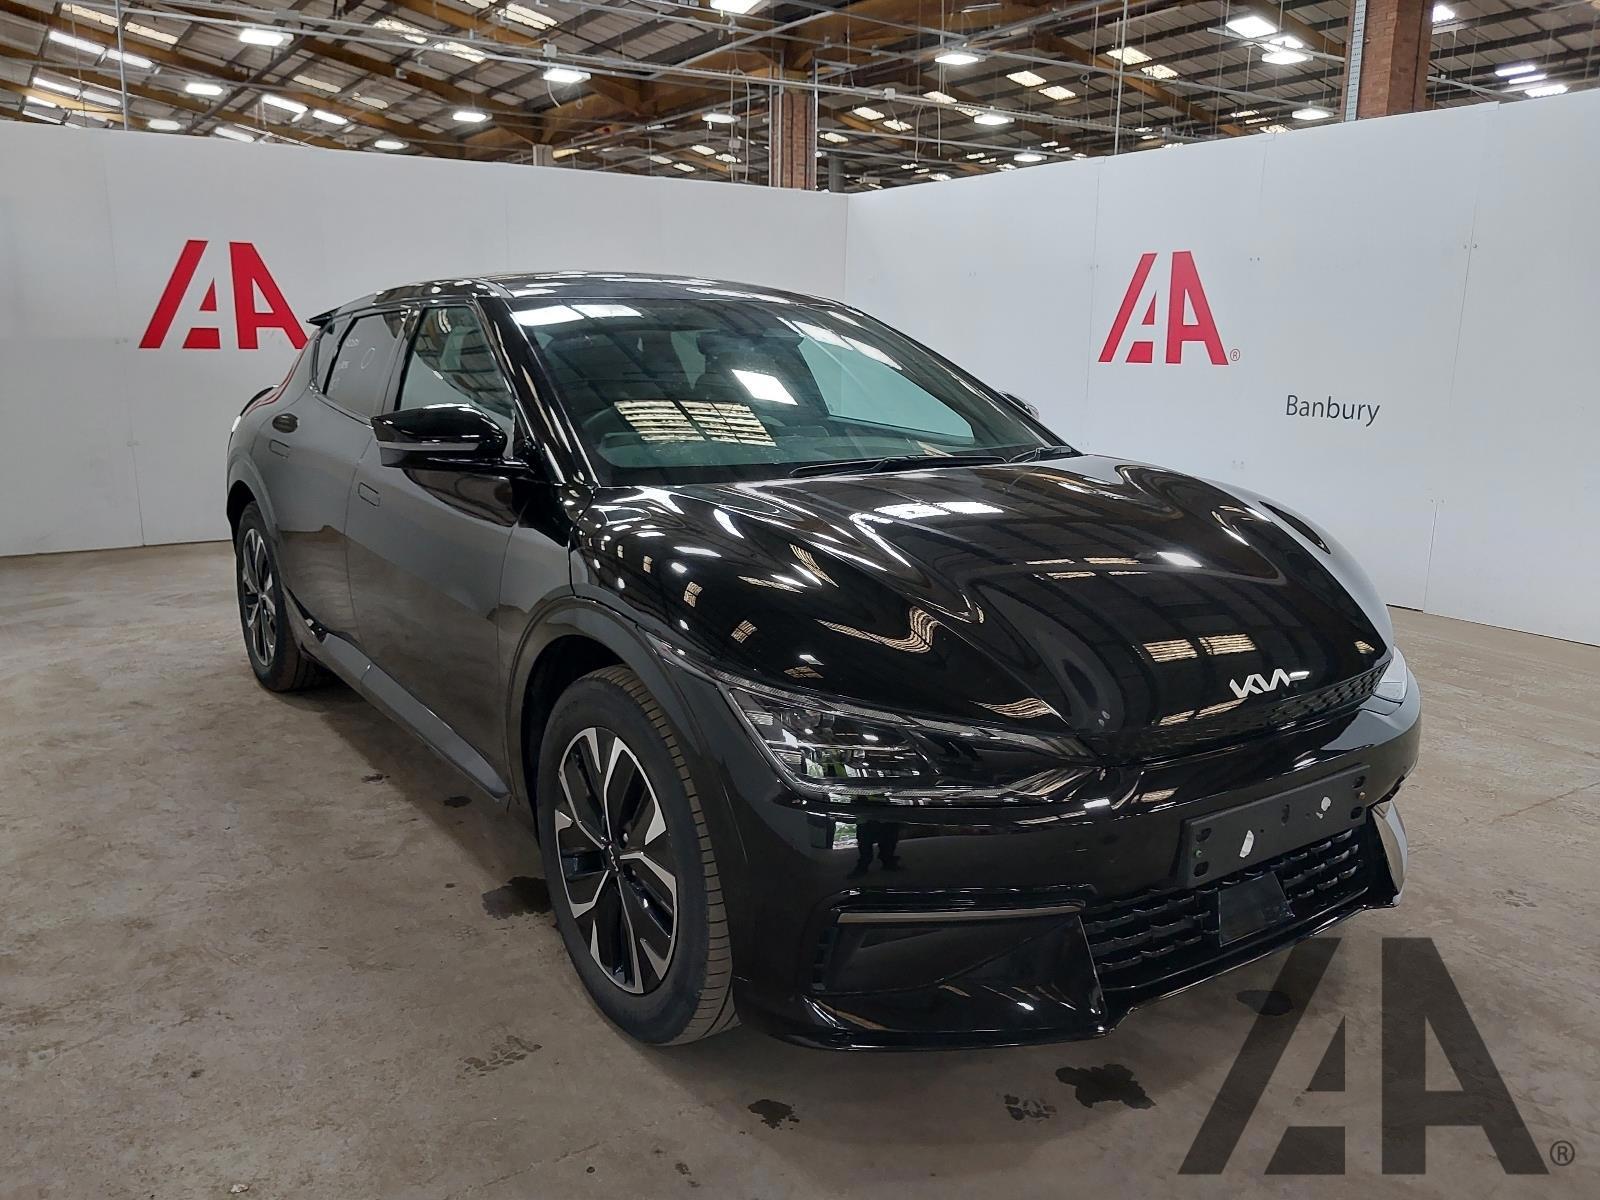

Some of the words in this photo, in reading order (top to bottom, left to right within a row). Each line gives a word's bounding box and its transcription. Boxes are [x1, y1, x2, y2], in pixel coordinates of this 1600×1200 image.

[138, 240, 308, 349] AA
[1098, 251, 1229, 365] AA
[1285, 394, 1381, 427] Banbury
[1229, 668, 1290, 699] KIA
